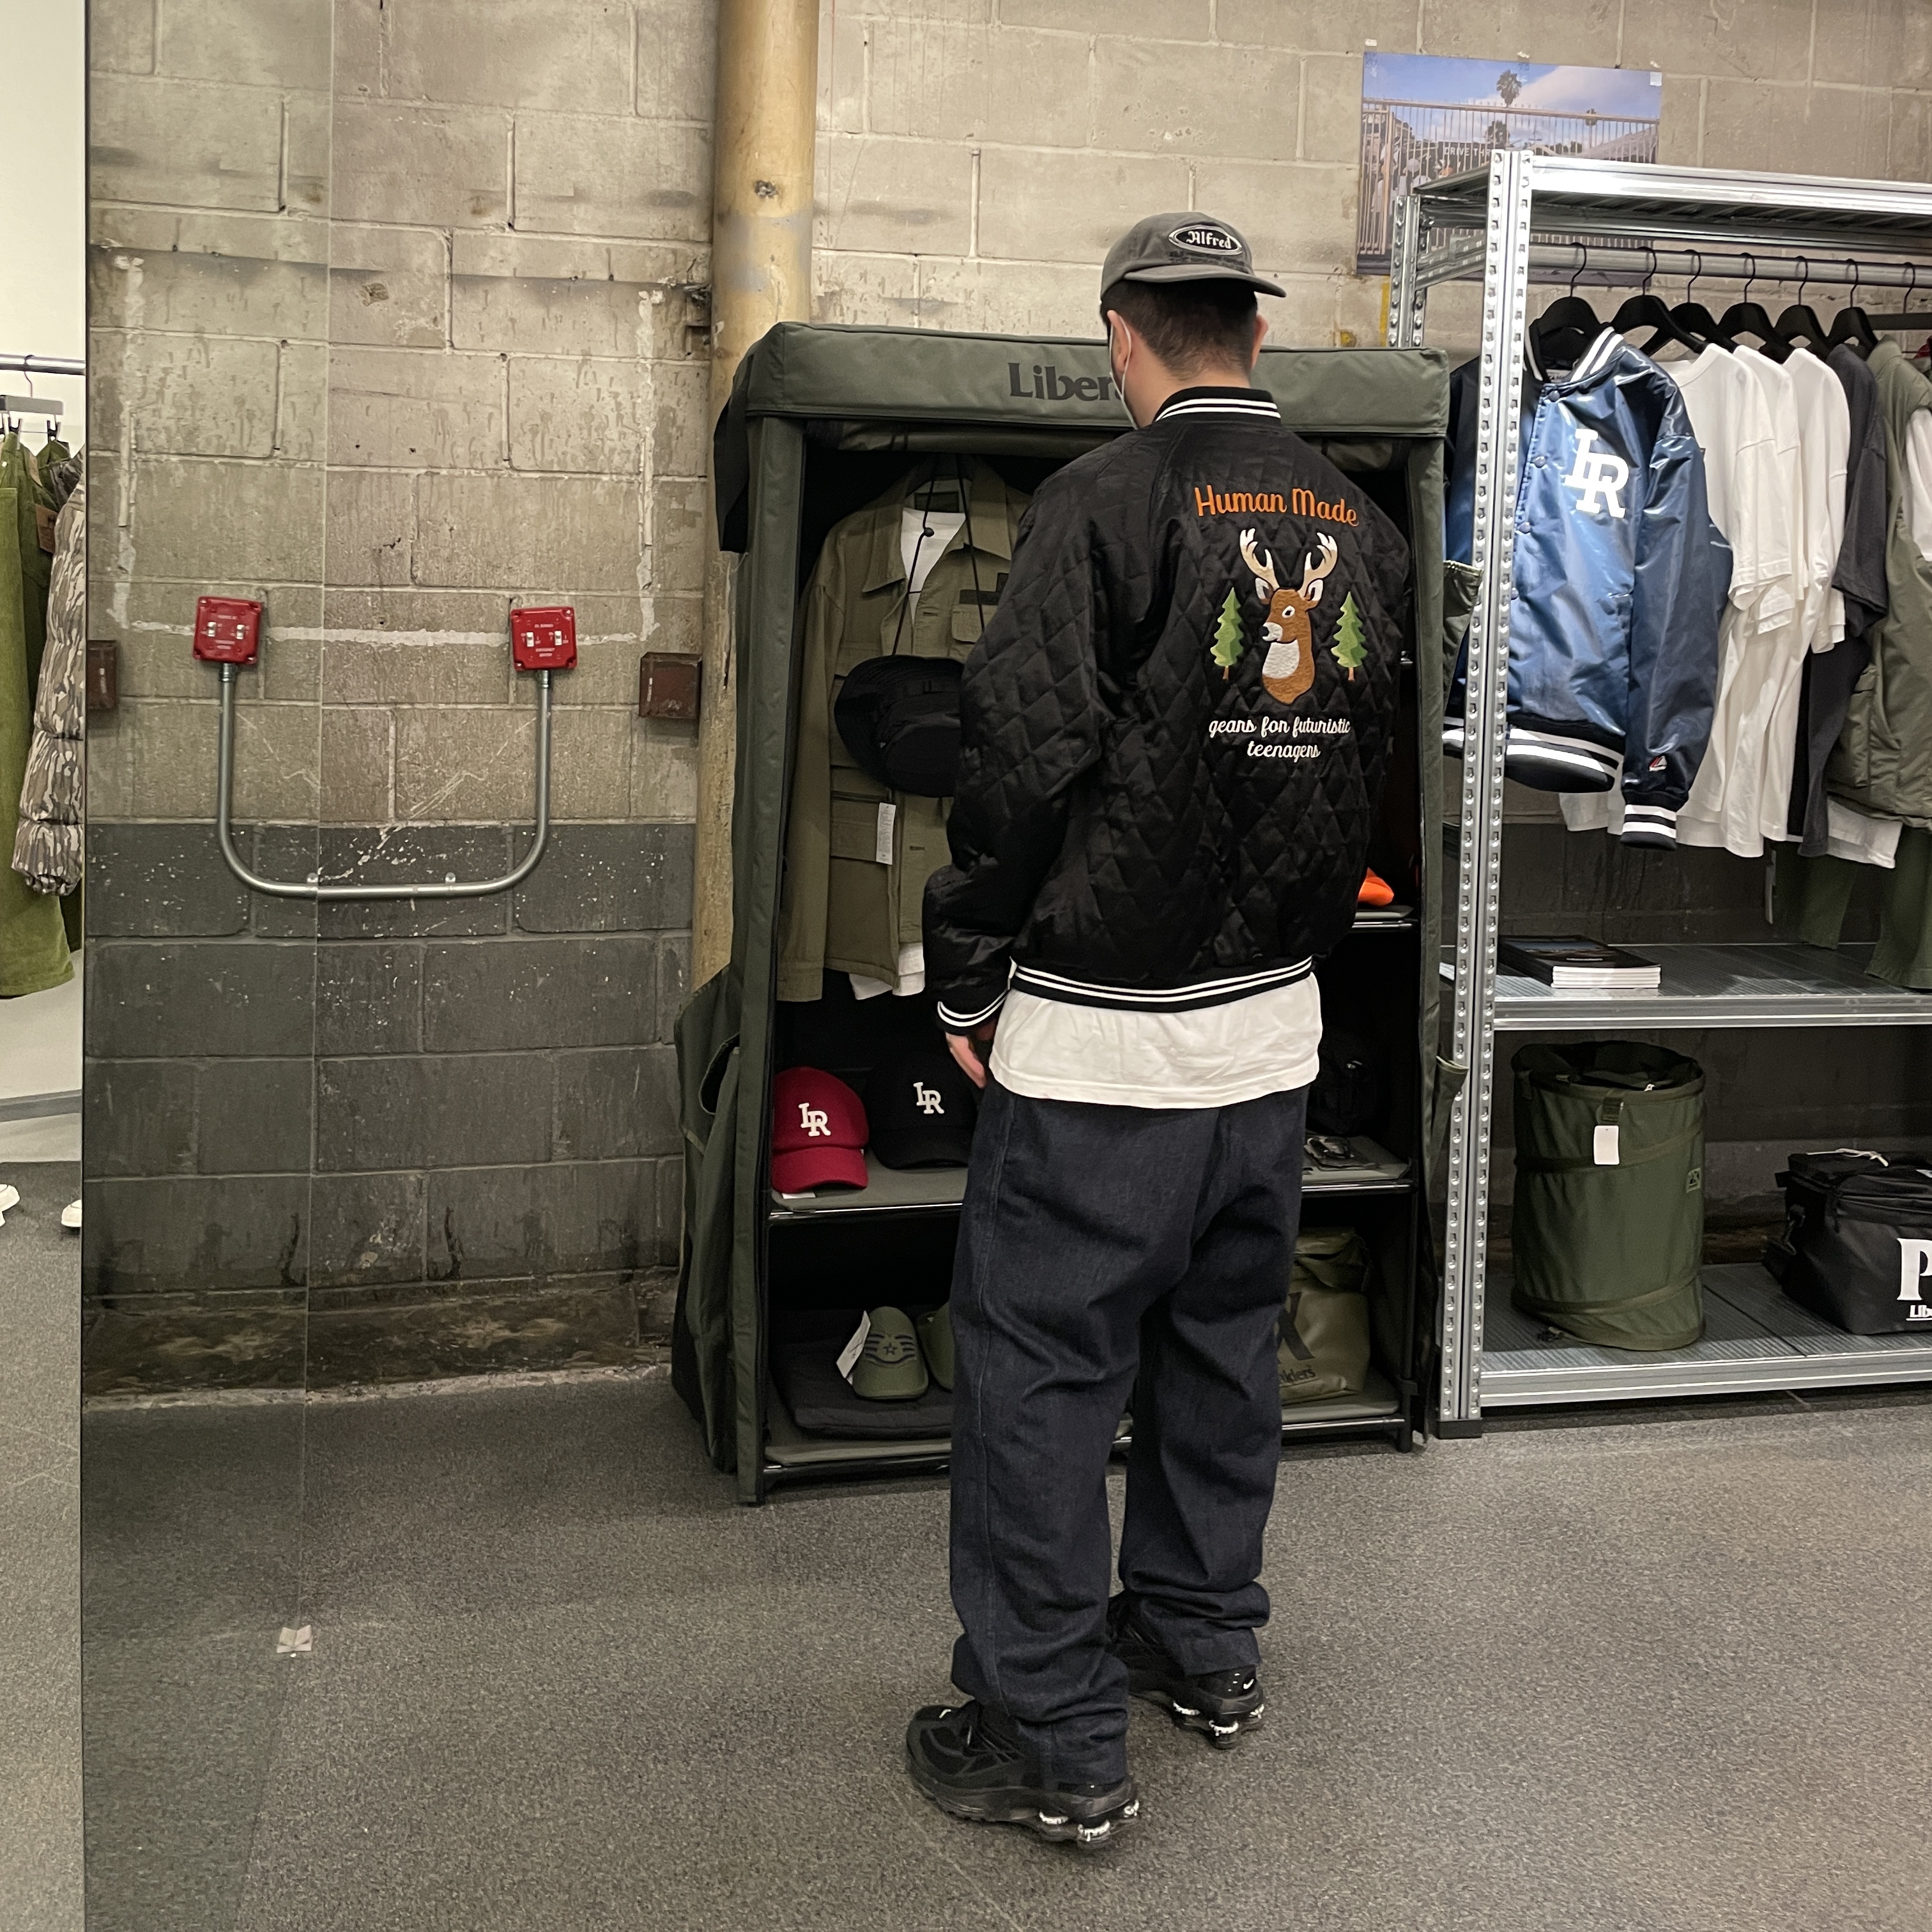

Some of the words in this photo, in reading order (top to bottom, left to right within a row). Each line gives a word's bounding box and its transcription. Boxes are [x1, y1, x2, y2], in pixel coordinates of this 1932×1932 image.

[1186, 231, 1232, 249] Alfred
[1008, 362, 1121, 401] Liber
[1564, 428, 1629, 519] LR
[1194, 484, 1287, 516] Human
[1292, 488, 1359, 526] Made
[1209, 720, 1257, 738] gears
[1261, 716, 1290, 738] for
[1292, 716, 1351, 738] futuristic
[1246, 740, 1321, 763] teenagers
[912, 1082, 944, 1114] LR
[798, 1102, 831, 1137] LR
[1910, 1305, 1932, 1317] Lib
